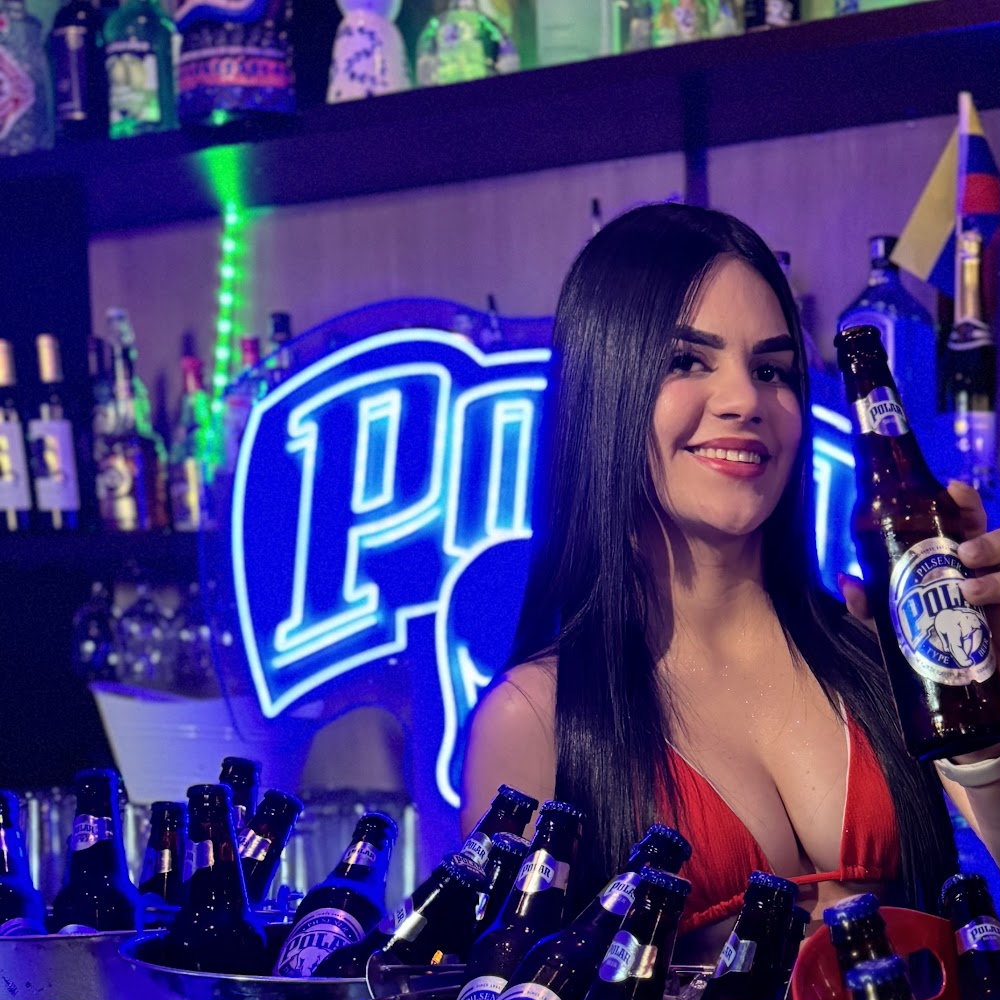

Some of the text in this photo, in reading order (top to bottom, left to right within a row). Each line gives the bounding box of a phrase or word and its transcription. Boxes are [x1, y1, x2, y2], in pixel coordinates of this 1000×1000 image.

[916, 555, 962, 577] PILSENER
[901, 583, 980, 641] POL
[926, 647, 950, 665] TYPE
[464, 839, 486, 860] POLAR
[609, 881, 635, 900] POLA
[285, 933, 347, 958] POLA
[610, 942, 631, 964] OLAR
